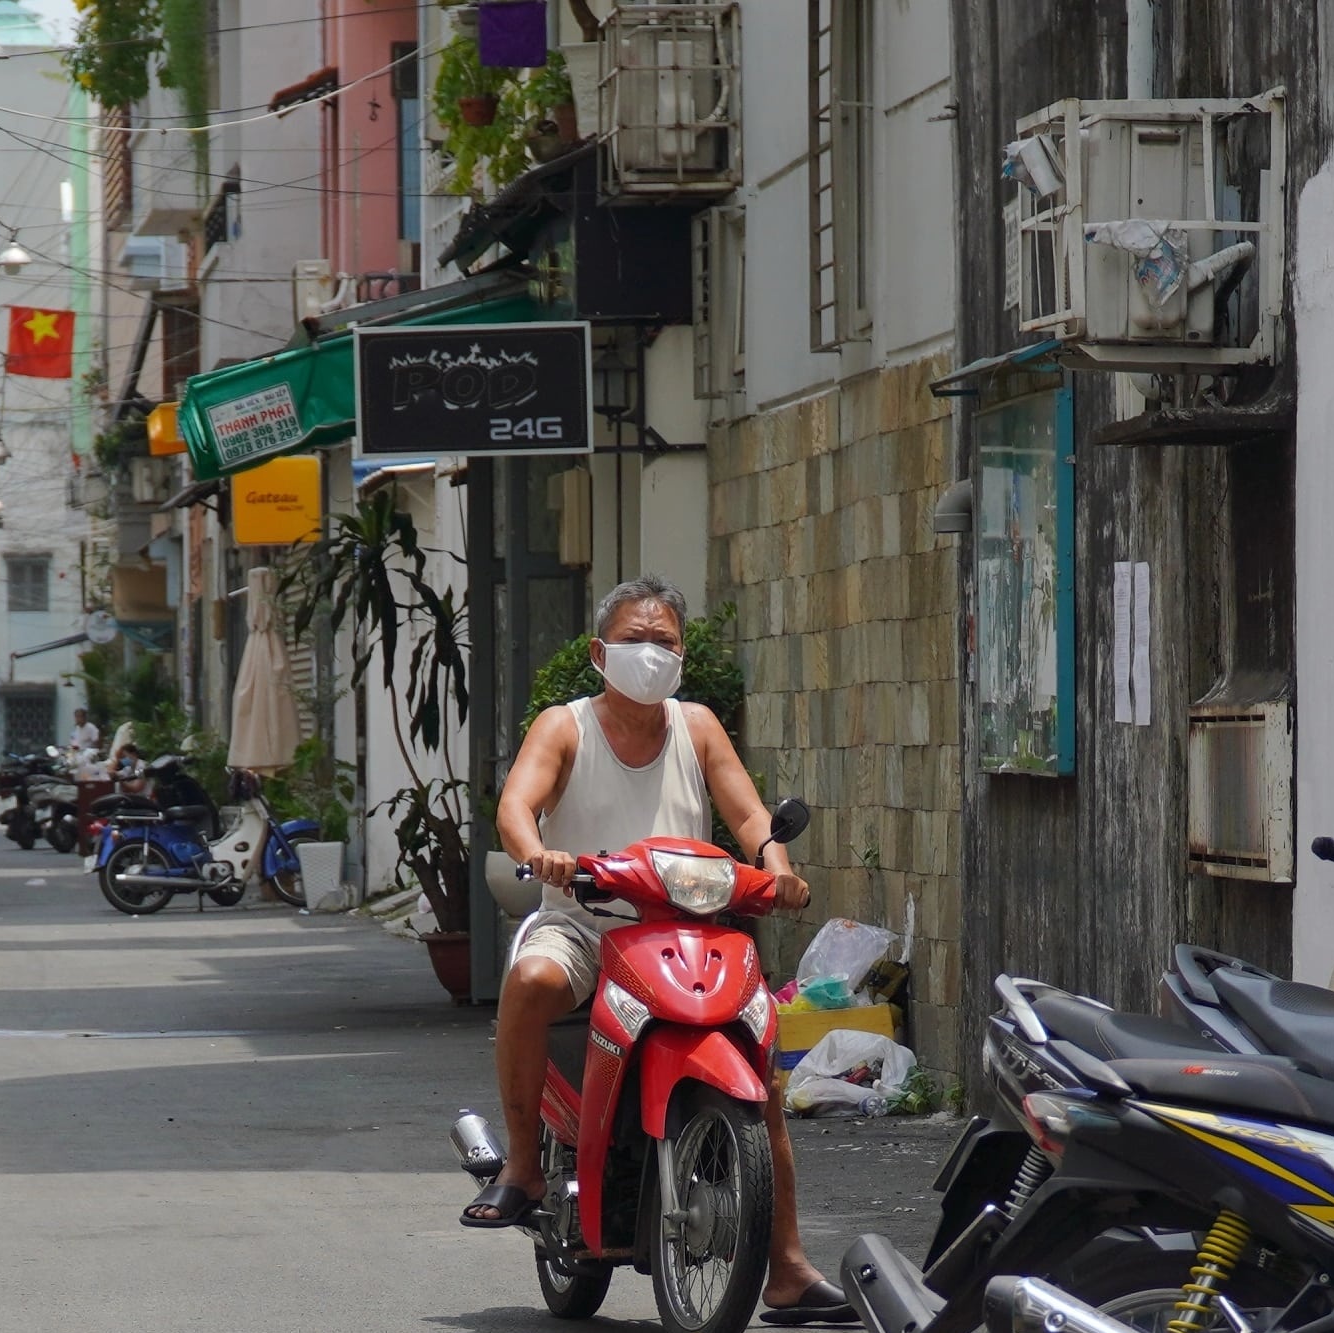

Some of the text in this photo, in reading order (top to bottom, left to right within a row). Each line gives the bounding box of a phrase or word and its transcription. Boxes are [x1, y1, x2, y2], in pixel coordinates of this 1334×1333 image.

[276, 416, 297, 431] 319
[489, 416, 563, 440] 24G
[225, 443, 253, 459] 0978
[590, 1030, 621, 1055] SUZUKI
